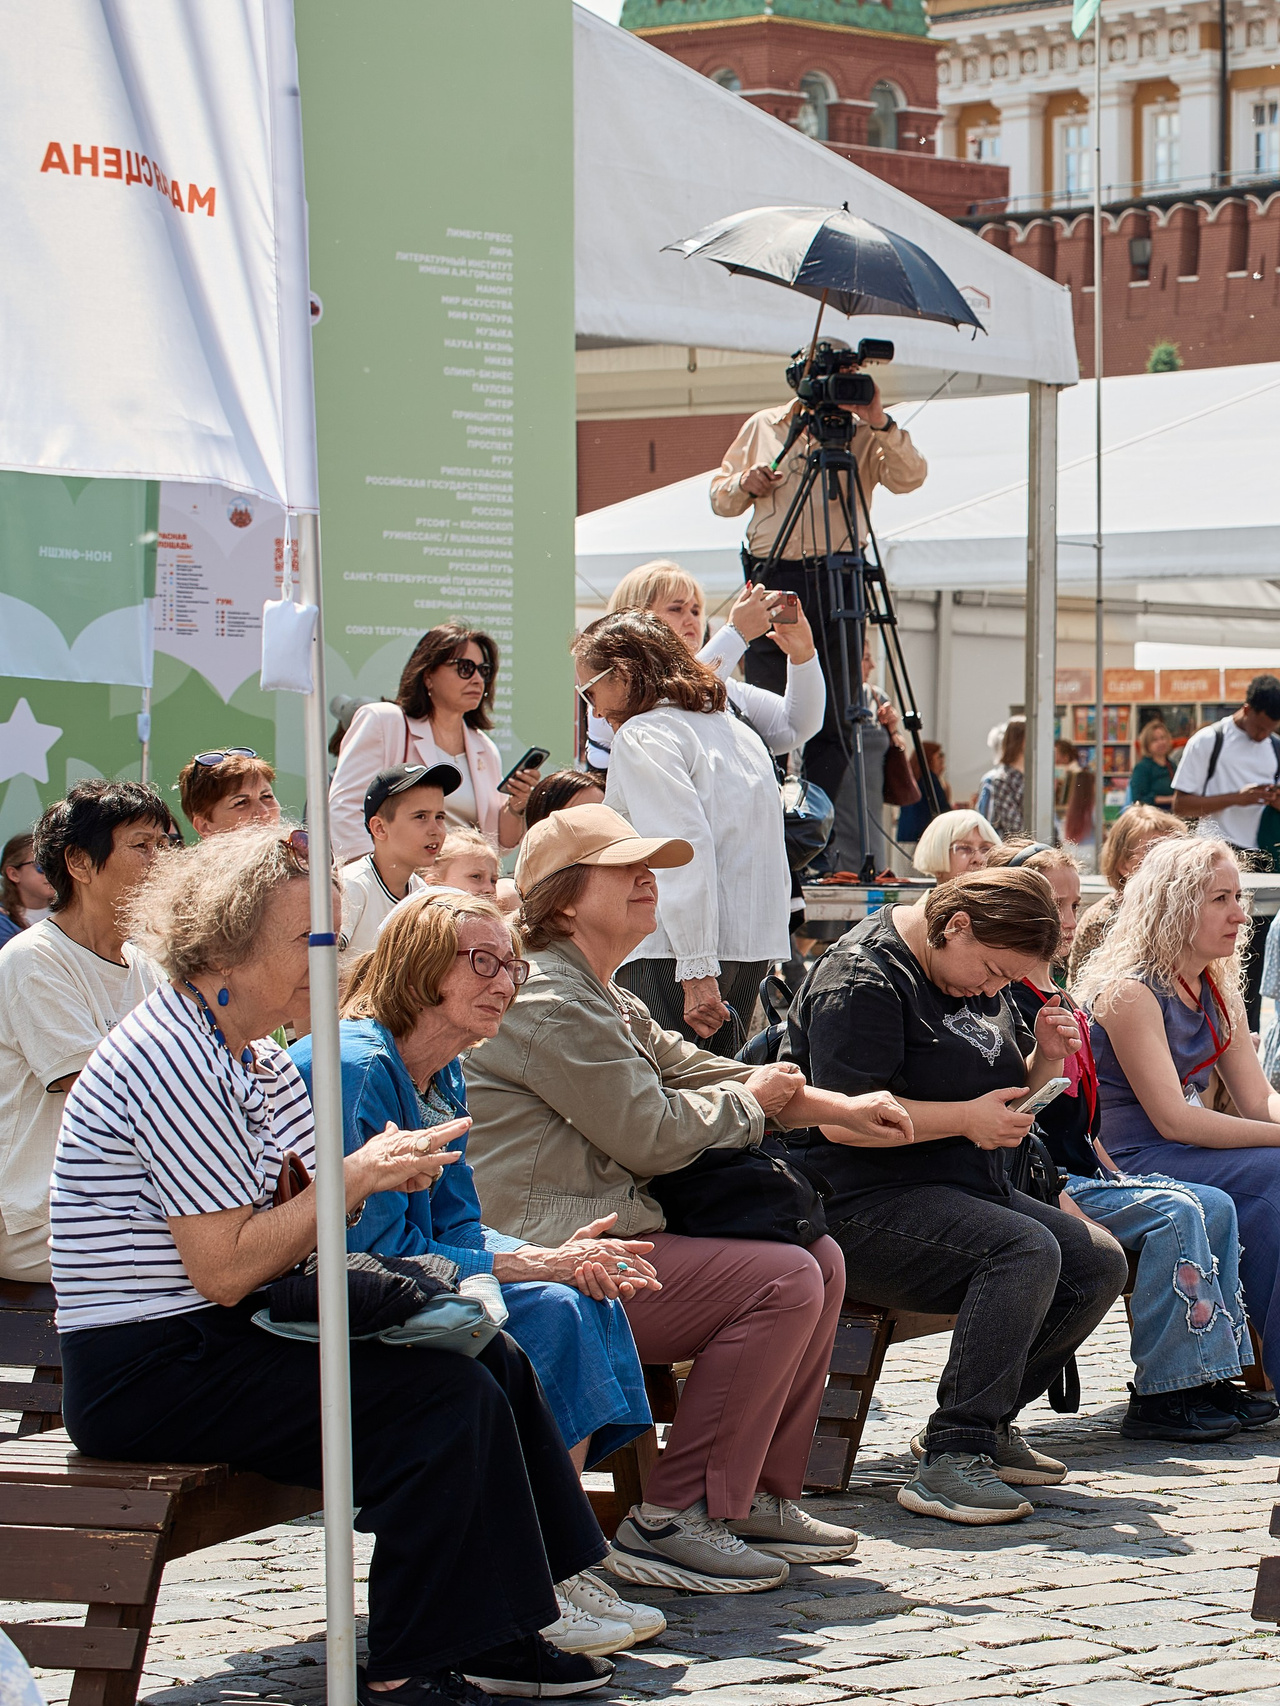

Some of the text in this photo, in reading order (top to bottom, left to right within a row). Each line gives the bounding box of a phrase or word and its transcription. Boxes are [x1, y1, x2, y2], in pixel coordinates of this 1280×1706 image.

[484, 231, 513, 243] ПРЕСС
[396, 251, 513, 271] ЛИТЕРАТУРНЫЙ ИНСТИТУТ
[476, 284, 513, 296] МАМОНТ
[462, 297, 513, 310] ИСКУССТВА
[469, 312, 513, 324] КУЛЬТУРА
[476, 327, 513, 338] МУЗЫКА
[444, 338, 514, 352] НАУКА И ЖИЗНЬ
[484, 398, 513, 409] ПИТЕР
[466, 425, 513, 437] ПРОМЕТЕЙ
[467, 439, 513, 451] ПРОСПЕКТ
[441, 466, 513, 479] РИПОЛ КЛАССИК
[365, 475, 513, 493] РОССИЙСКАЯ ГОСУДАРСТВЕННАЯ
[456, 491, 513, 503] БИБЛИОТЕКА
[423, 546, 513, 559] РУССКАЯ ПАНОРАМА
[449, 560, 513, 574] РУССКИЙ ПУТЬ
[343, 571, 513, 587] САНКТ-ПЕТЕРБУРГСКИЙ ПУШКИНСКИЙ
[440, 586, 513, 597] ФОНД КУЛЬТУРЫ
[413, 599, 462, 609] СЕВЕРНЫЙ
[346, 625, 373, 635] СОЮЗ
